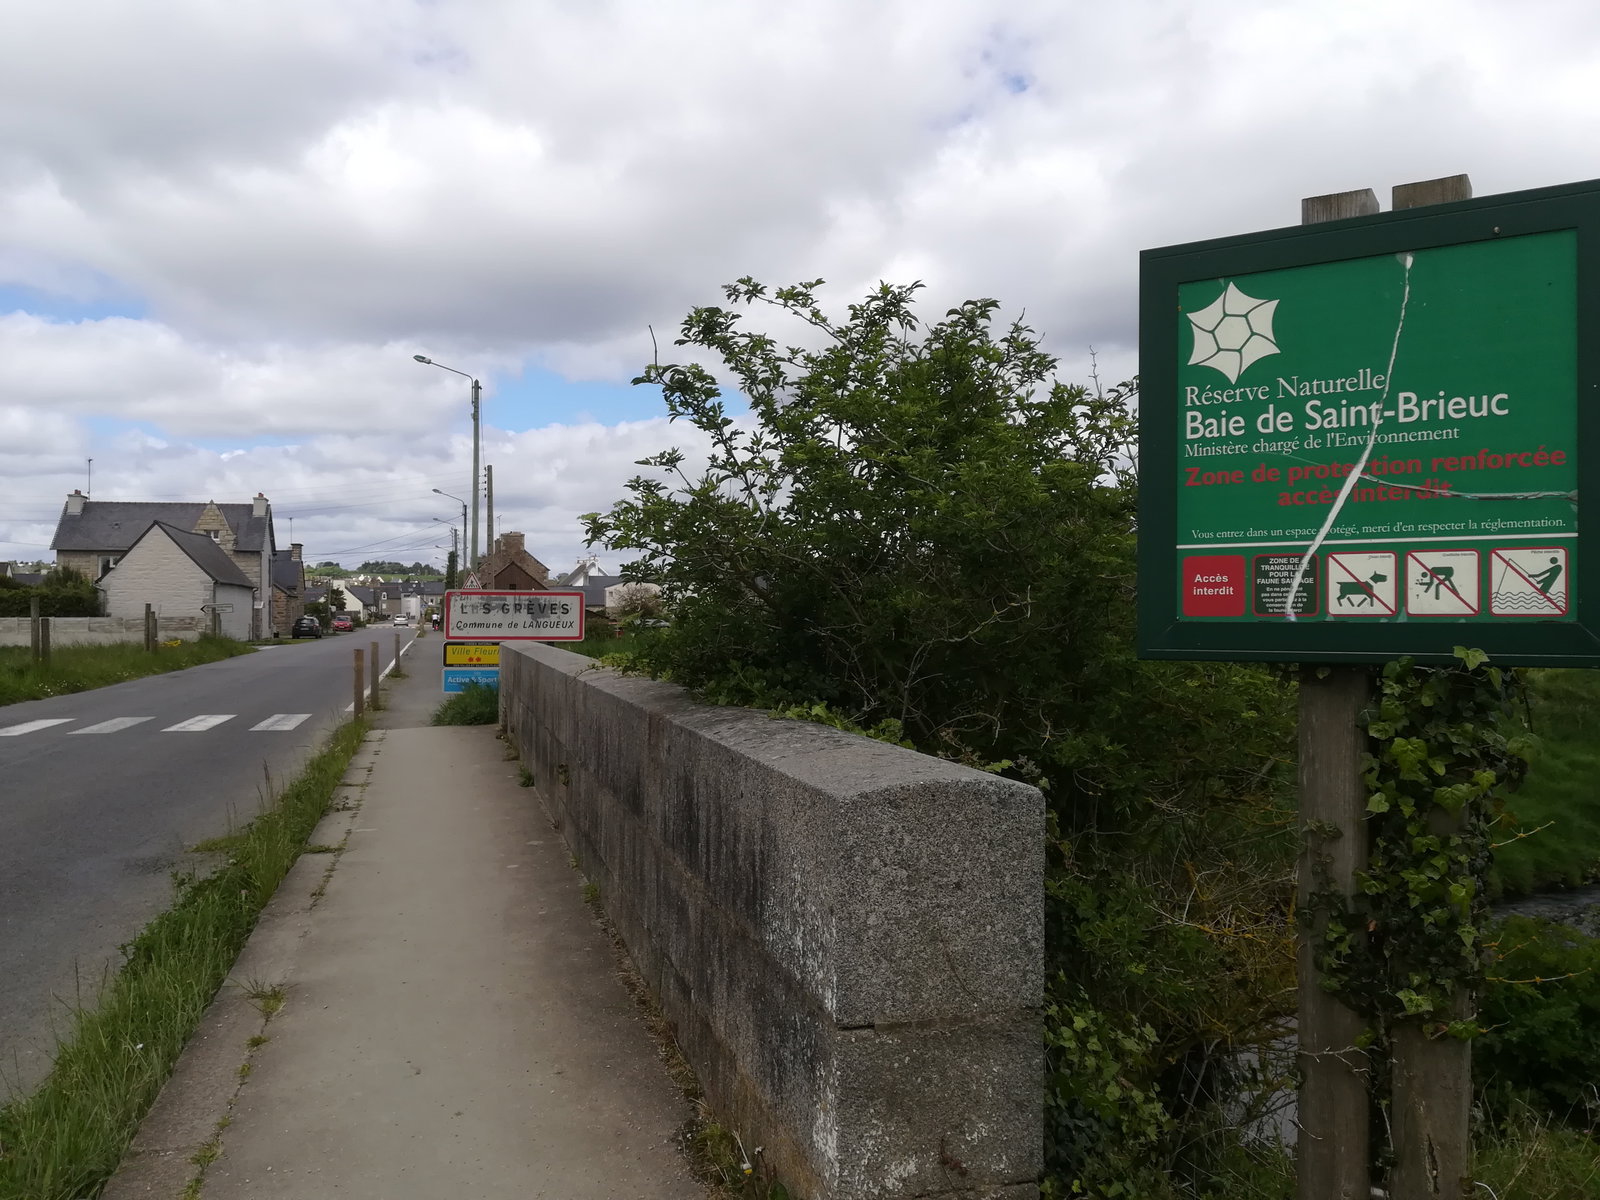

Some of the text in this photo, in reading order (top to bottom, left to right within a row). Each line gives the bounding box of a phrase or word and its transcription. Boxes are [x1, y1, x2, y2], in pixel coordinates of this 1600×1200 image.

[1185, 368, 1386, 407] Réserve Naturelle
[1186, 391, 1509, 439] Baie de Saint-Brieuc
[1185, 427, 1460, 457] Ministère chargé de l'Environnement
[1184, 467, 1244, 486] Zone
[1251, 463, 1280, 483] de
[1431, 445, 1567, 472] renforcée
[1353, 478, 1452, 503] interdit
[1192, 530, 1214, 539] Vous
[1216, 530, 1244, 538] entrez
[1247, 528, 1268, 537] dans
[1285, 528, 1317, 538] espace
[1362, 522, 1391, 533] merci
[1393, 522, 1415, 532] d'en
[1417, 520, 1466, 534] respecter
[1468, 519, 1478, 529] la
[1481, 516, 1566, 532] réglementation.
[1194, 573, 1229, 583] Accès
[1193, 586, 1234, 596] interdit
[460, 600, 570, 615] LS GRÈVES
[456, 620, 575, 630] Commune de LANGUEUX
[451, 647, 471, 655] Ville
